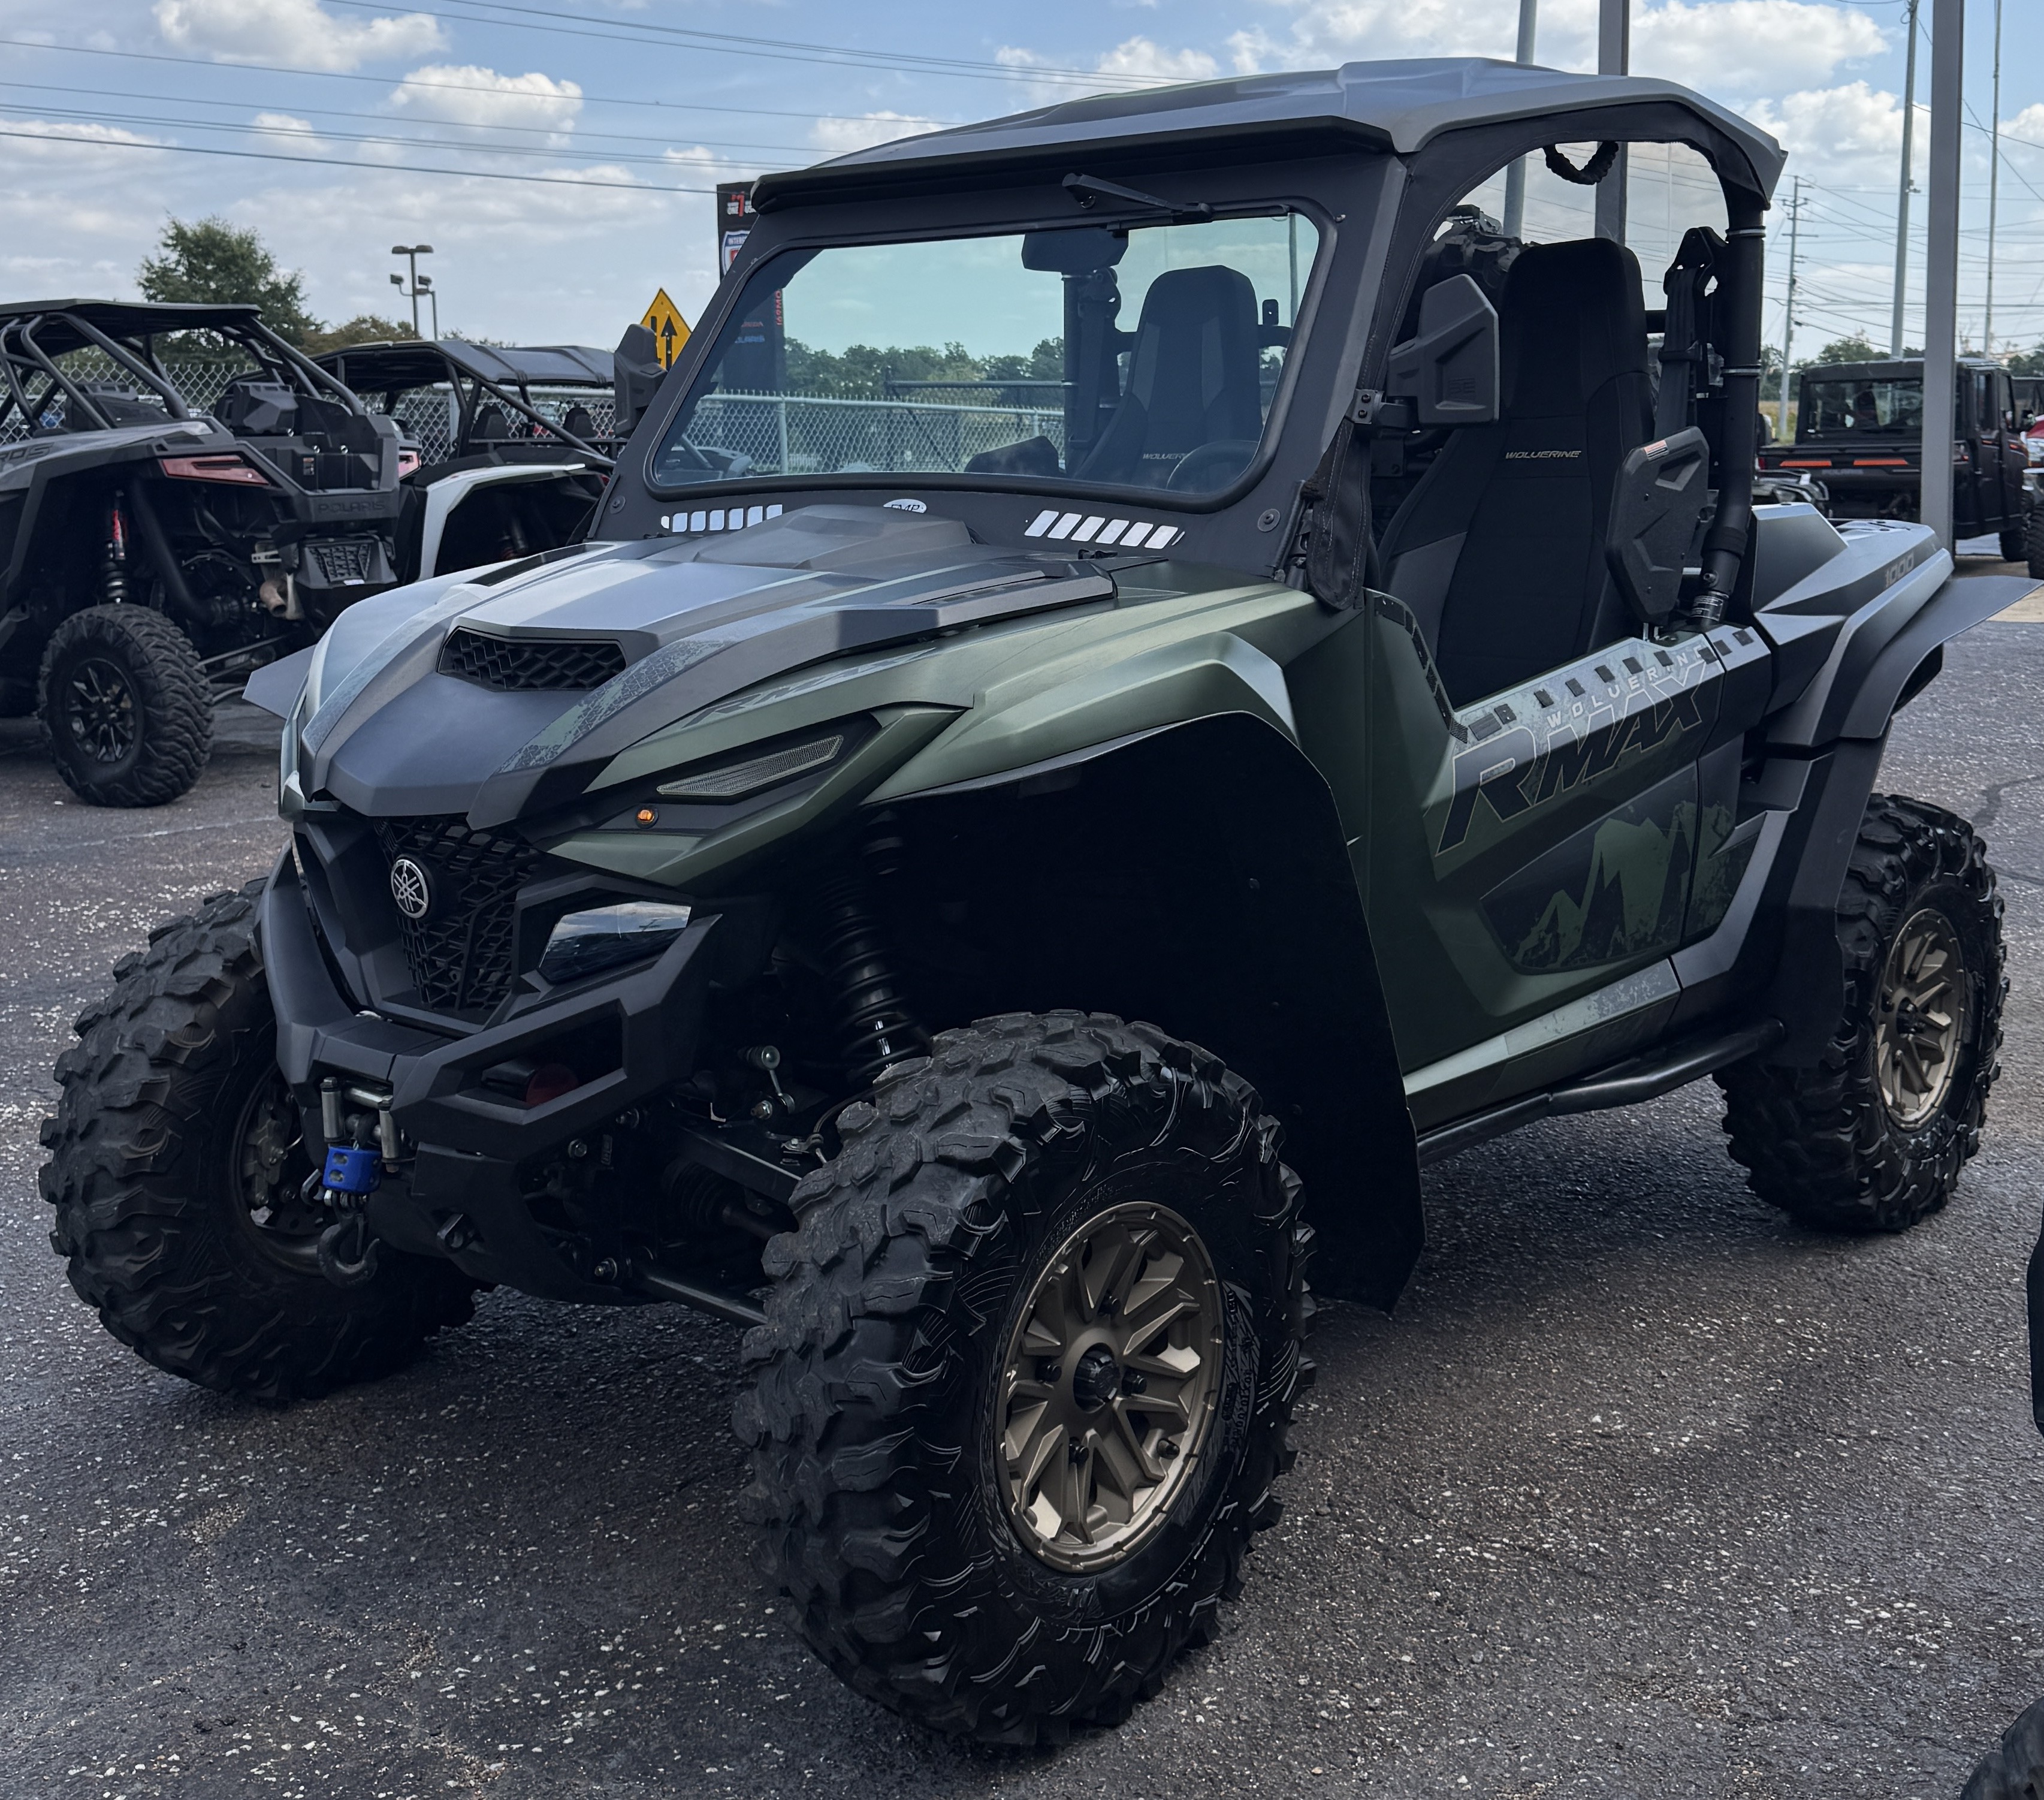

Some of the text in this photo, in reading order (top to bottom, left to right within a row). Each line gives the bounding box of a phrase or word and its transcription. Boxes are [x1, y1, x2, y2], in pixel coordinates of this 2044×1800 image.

[318, 500, 387, 514] POLARIS
[1885, 550, 1914, 589] 1000
[1435, 661, 1707, 858] RMAX
